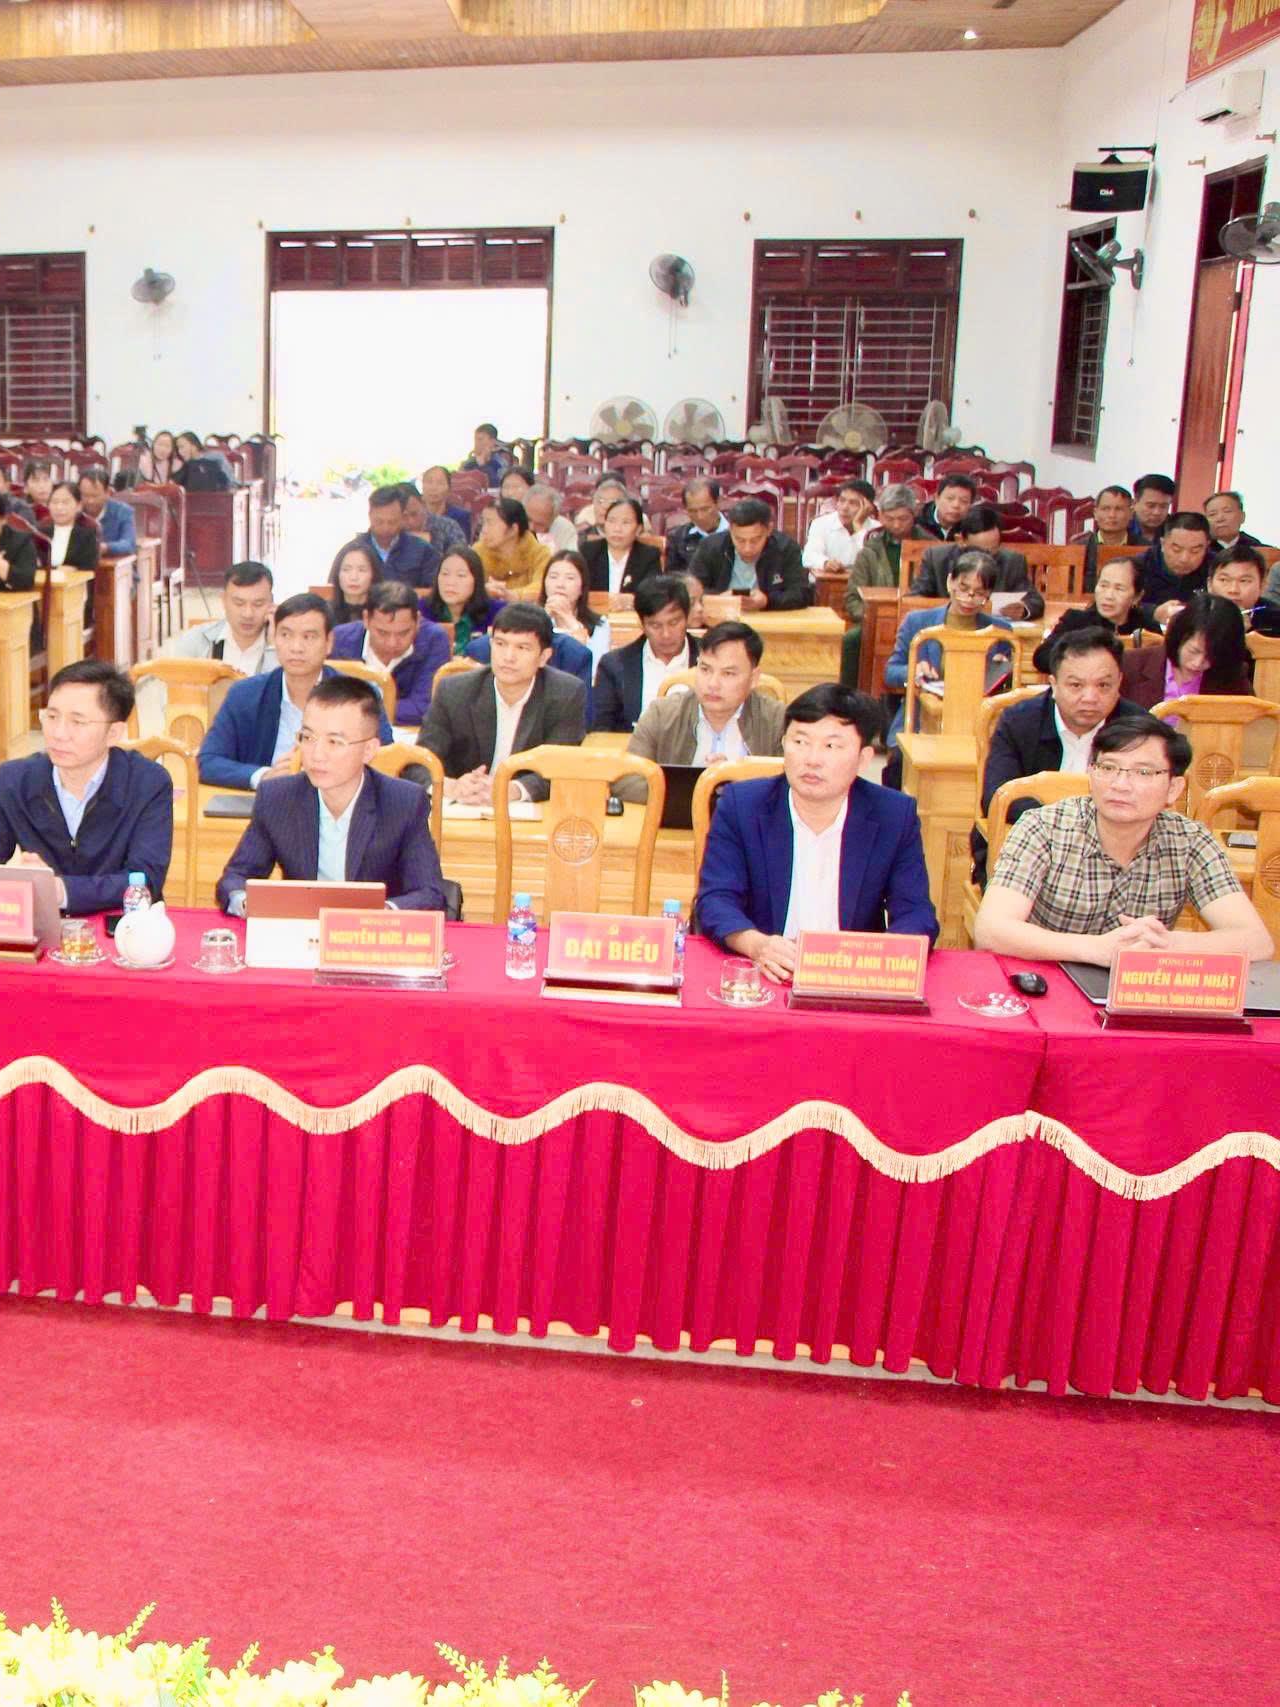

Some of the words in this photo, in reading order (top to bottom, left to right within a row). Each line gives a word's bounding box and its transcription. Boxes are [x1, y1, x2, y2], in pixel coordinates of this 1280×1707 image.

[329, 927, 377, 945] NGUYỄN
[405, 931, 431, 946] ANH
[565, 937, 601, 962] ĐẠI
[608, 934, 659, 963] BIỂU
[802, 951, 852, 968] NGUYỄN
[855, 955, 881, 970] ANH
[885, 955, 918, 973] TUẤN
[1121, 967, 1171, 986] NGUYỄN
[1174, 971, 1201, 987] ANH
[1203, 972, 1237, 991] NHẬT
